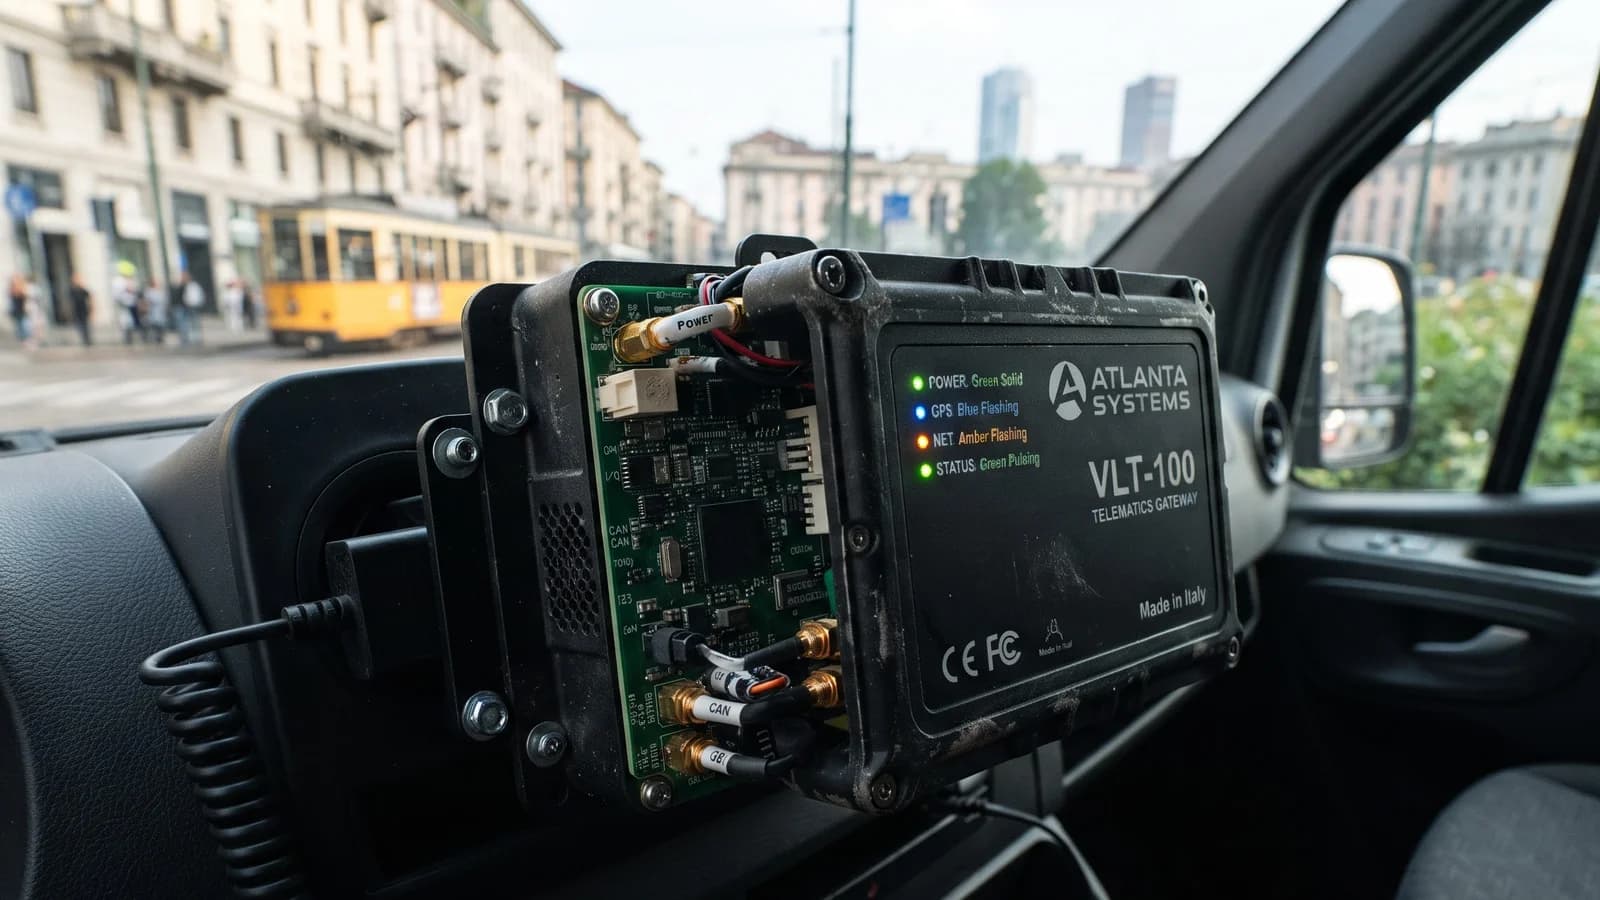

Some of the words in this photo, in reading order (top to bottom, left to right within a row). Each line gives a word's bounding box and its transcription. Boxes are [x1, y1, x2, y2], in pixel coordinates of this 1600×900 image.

[971, 373, 999, 387] Green
[1000, 371, 1024, 386] Solid
[1091, 365, 1188, 390] ATLANTA
[957, 402, 979, 416] Blue
[1093, 391, 1191, 415] SYSTEMS
[959, 430, 989, 445] Amber
[990, 426, 1028, 443] Flashing
[980, 457, 1007, 471] Green
[1088, 449, 1196, 498] VLT-100
[1091, 499, 1154, 524] TELEMATICS
[1155, 491, 1198, 512] GATEWAY
[609, 525, 629, 536] CAN
[611, 537, 630, 549] CAN
[1140, 597, 1170, 619] Made
[1171, 593, 1183, 609] in
[709, 702, 731, 716] CAN
